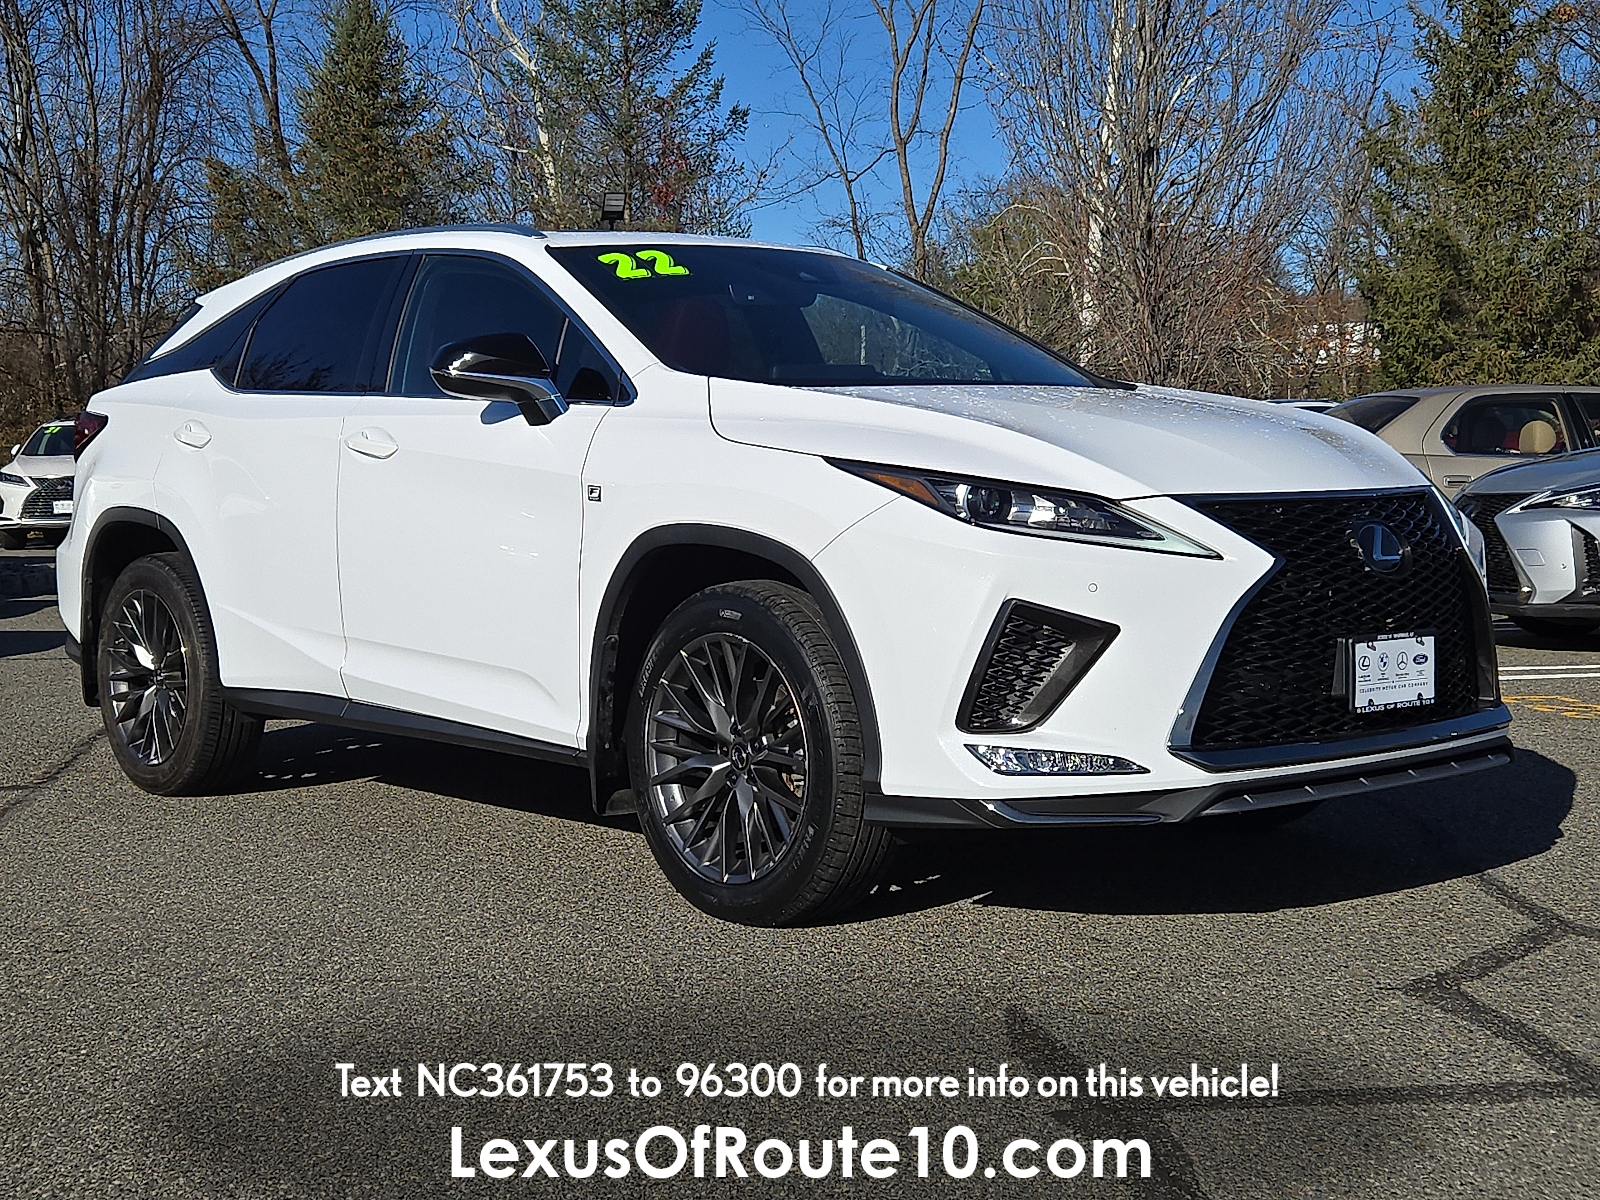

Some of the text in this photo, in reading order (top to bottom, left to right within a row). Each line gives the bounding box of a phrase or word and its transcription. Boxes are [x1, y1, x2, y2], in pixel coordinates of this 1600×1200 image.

[598, 249, 690, 280] 22
[1362, 705, 1384, 713] LEXUS
[1397, 700, 1420, 708] ROUTE
